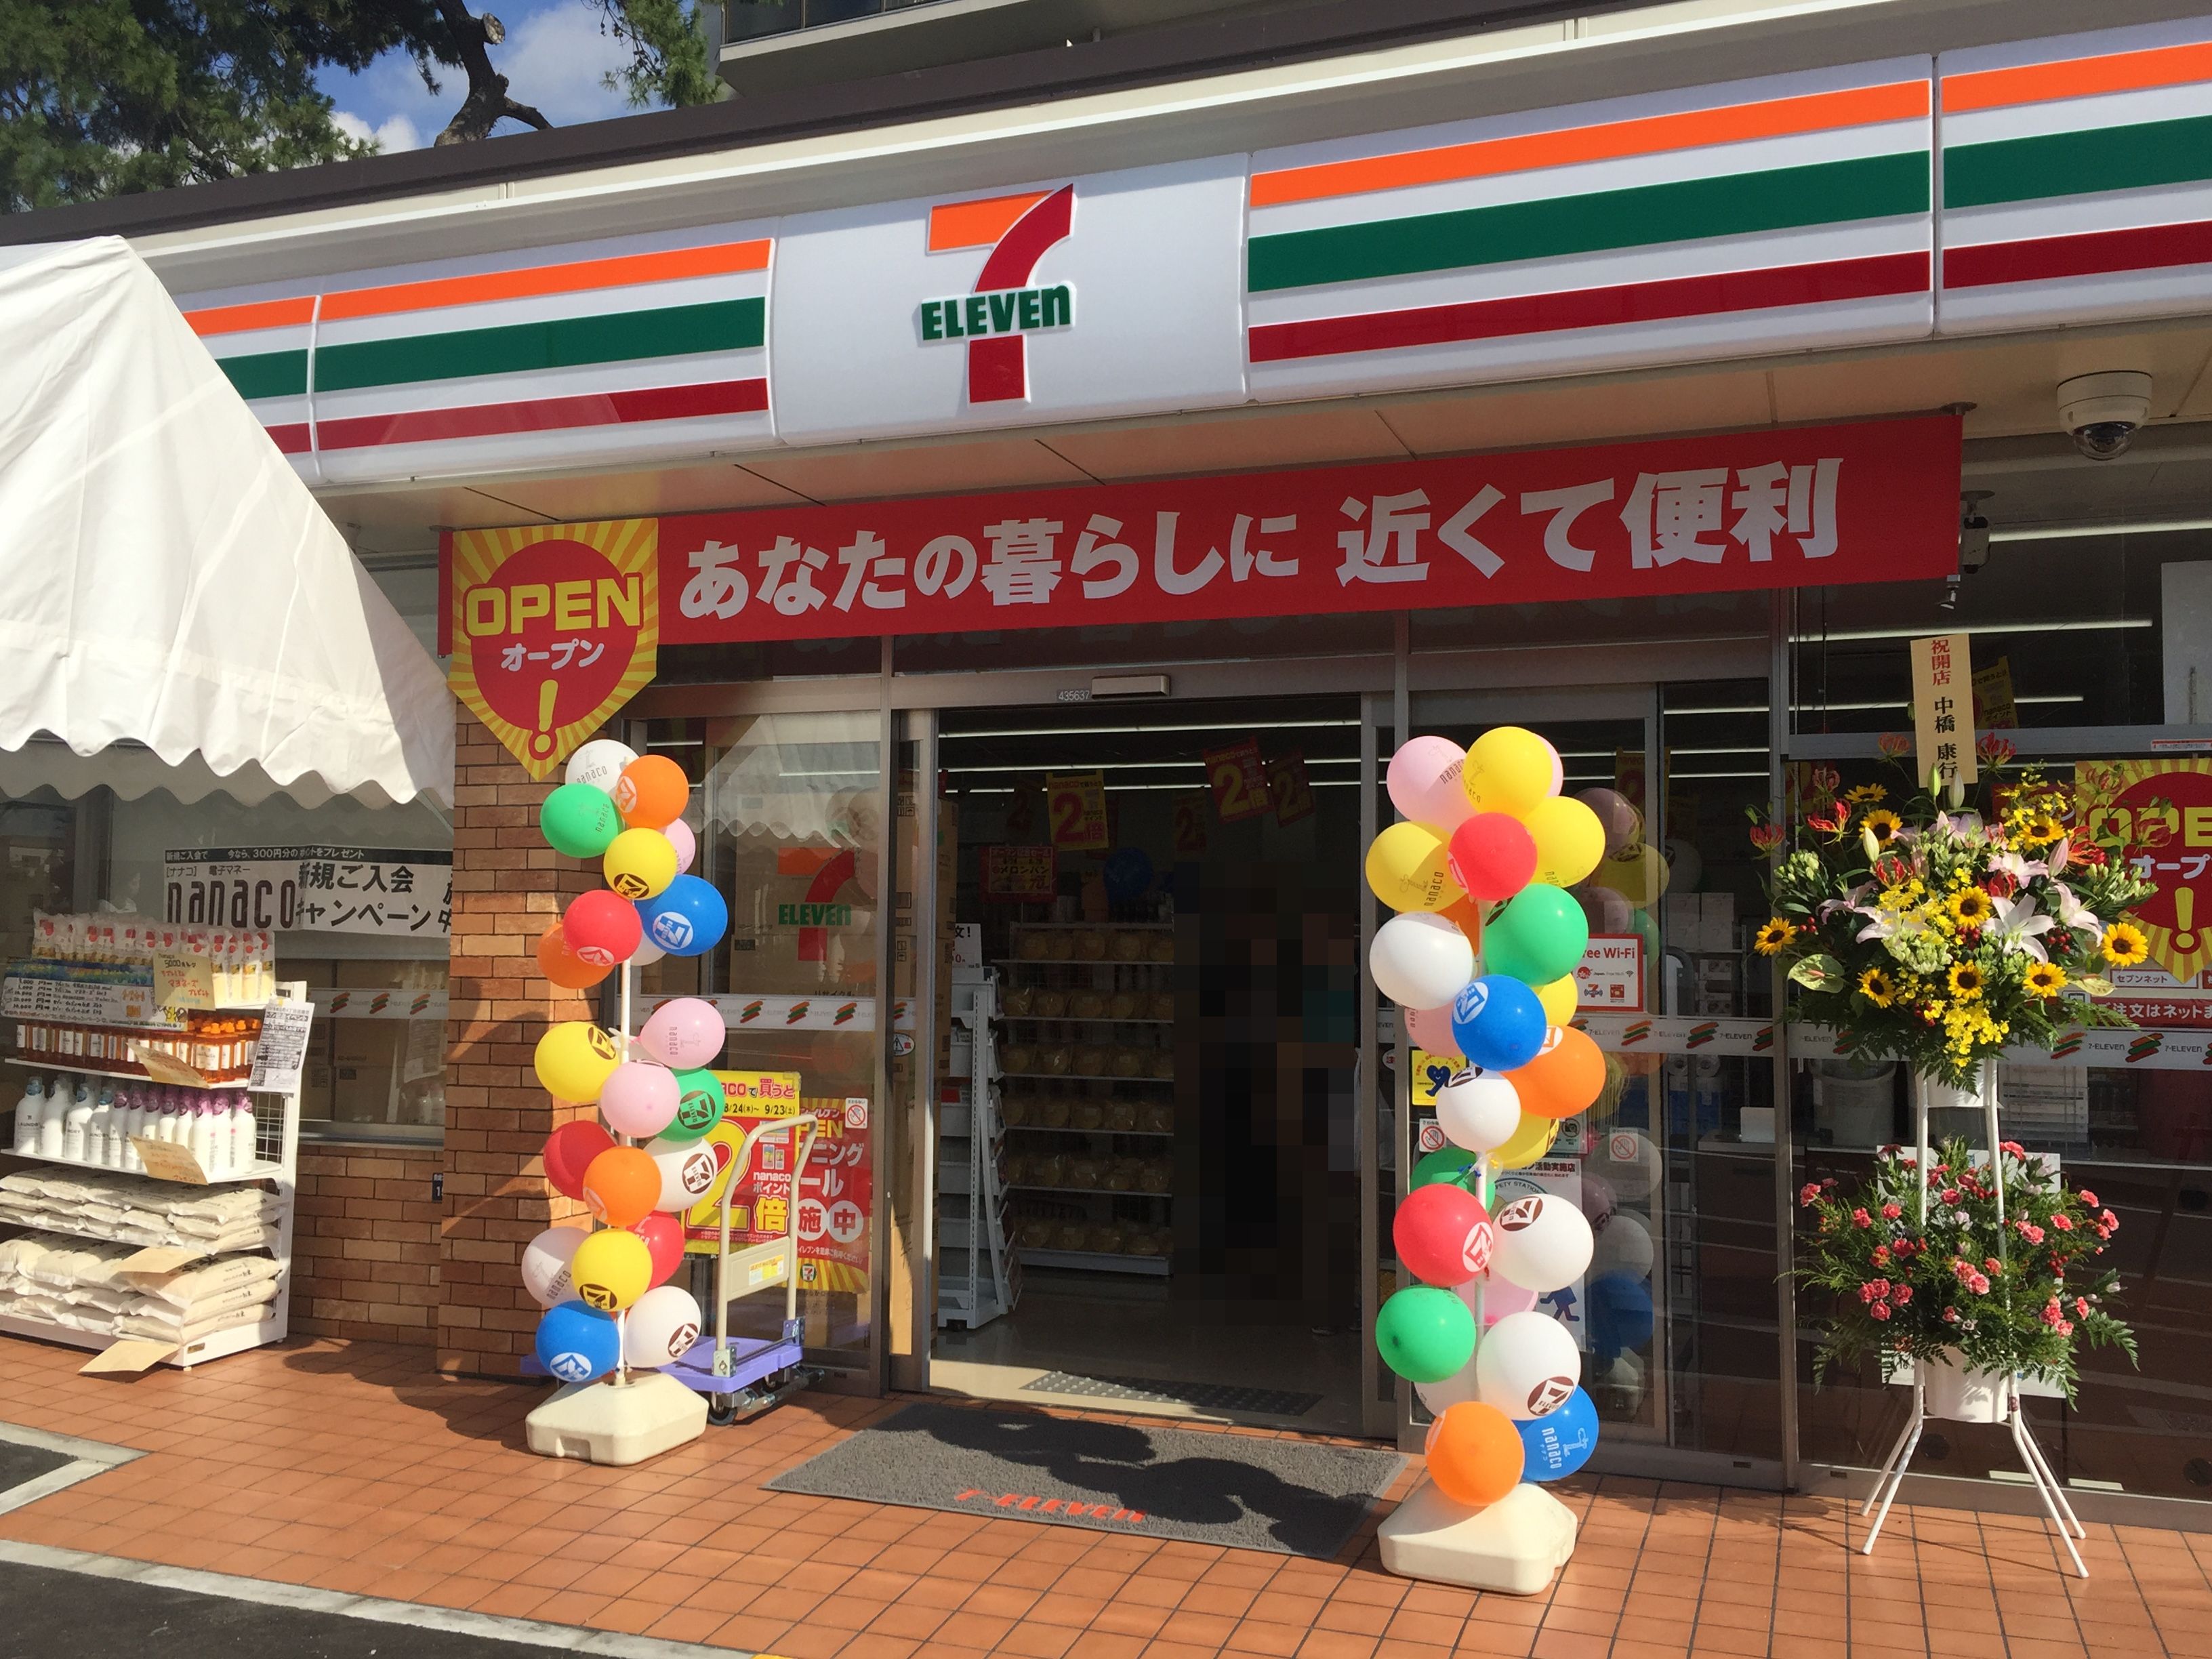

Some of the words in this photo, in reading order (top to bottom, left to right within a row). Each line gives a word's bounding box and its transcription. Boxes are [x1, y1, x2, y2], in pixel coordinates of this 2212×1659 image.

[929, 183, 1073, 403] 7
[679, 511, 1299, 620] あなたの暮らしに
[1337, 457, 1844, 588] 近くて便利
[466, 577, 640, 636] OPEN
[501, 638, 604, 672] オープン
[1931, 639, 1950, 686] 祝開店
[1059, 690, 1090, 701] 435637
[1934, 697, 1955, 733] 中橋
[1439, 758, 1465, 784] nanac
[1937, 743, 1957, 779] 康行
[2089, 807, 2212, 847] OPE
[209, 865, 251, 876] 電子マネー
[298, 861, 415, 894] 新規ご入会
[2129, 854, 2212, 880] オープ
[168, 880, 295, 928] nanaco
[1423, 872, 1444, 907] nanaco
[955, 925, 971, 938] 文!
[1582, 949, 1601, 959] ree
[1603, 947, 1635, 959] Wi-Fi
[2117, 974, 2168, 983] セブンネット
[2098, 1002, 2212, 1019] 注文はネットま
[721, 1078, 795, 1098] acoで買うと
[753, 1172, 791, 1181] nanaco
[800, 1168, 844, 1197] ール
[756, 1197, 788, 1231] 倍
[1542, 1427, 1561, 1469] nanaco
